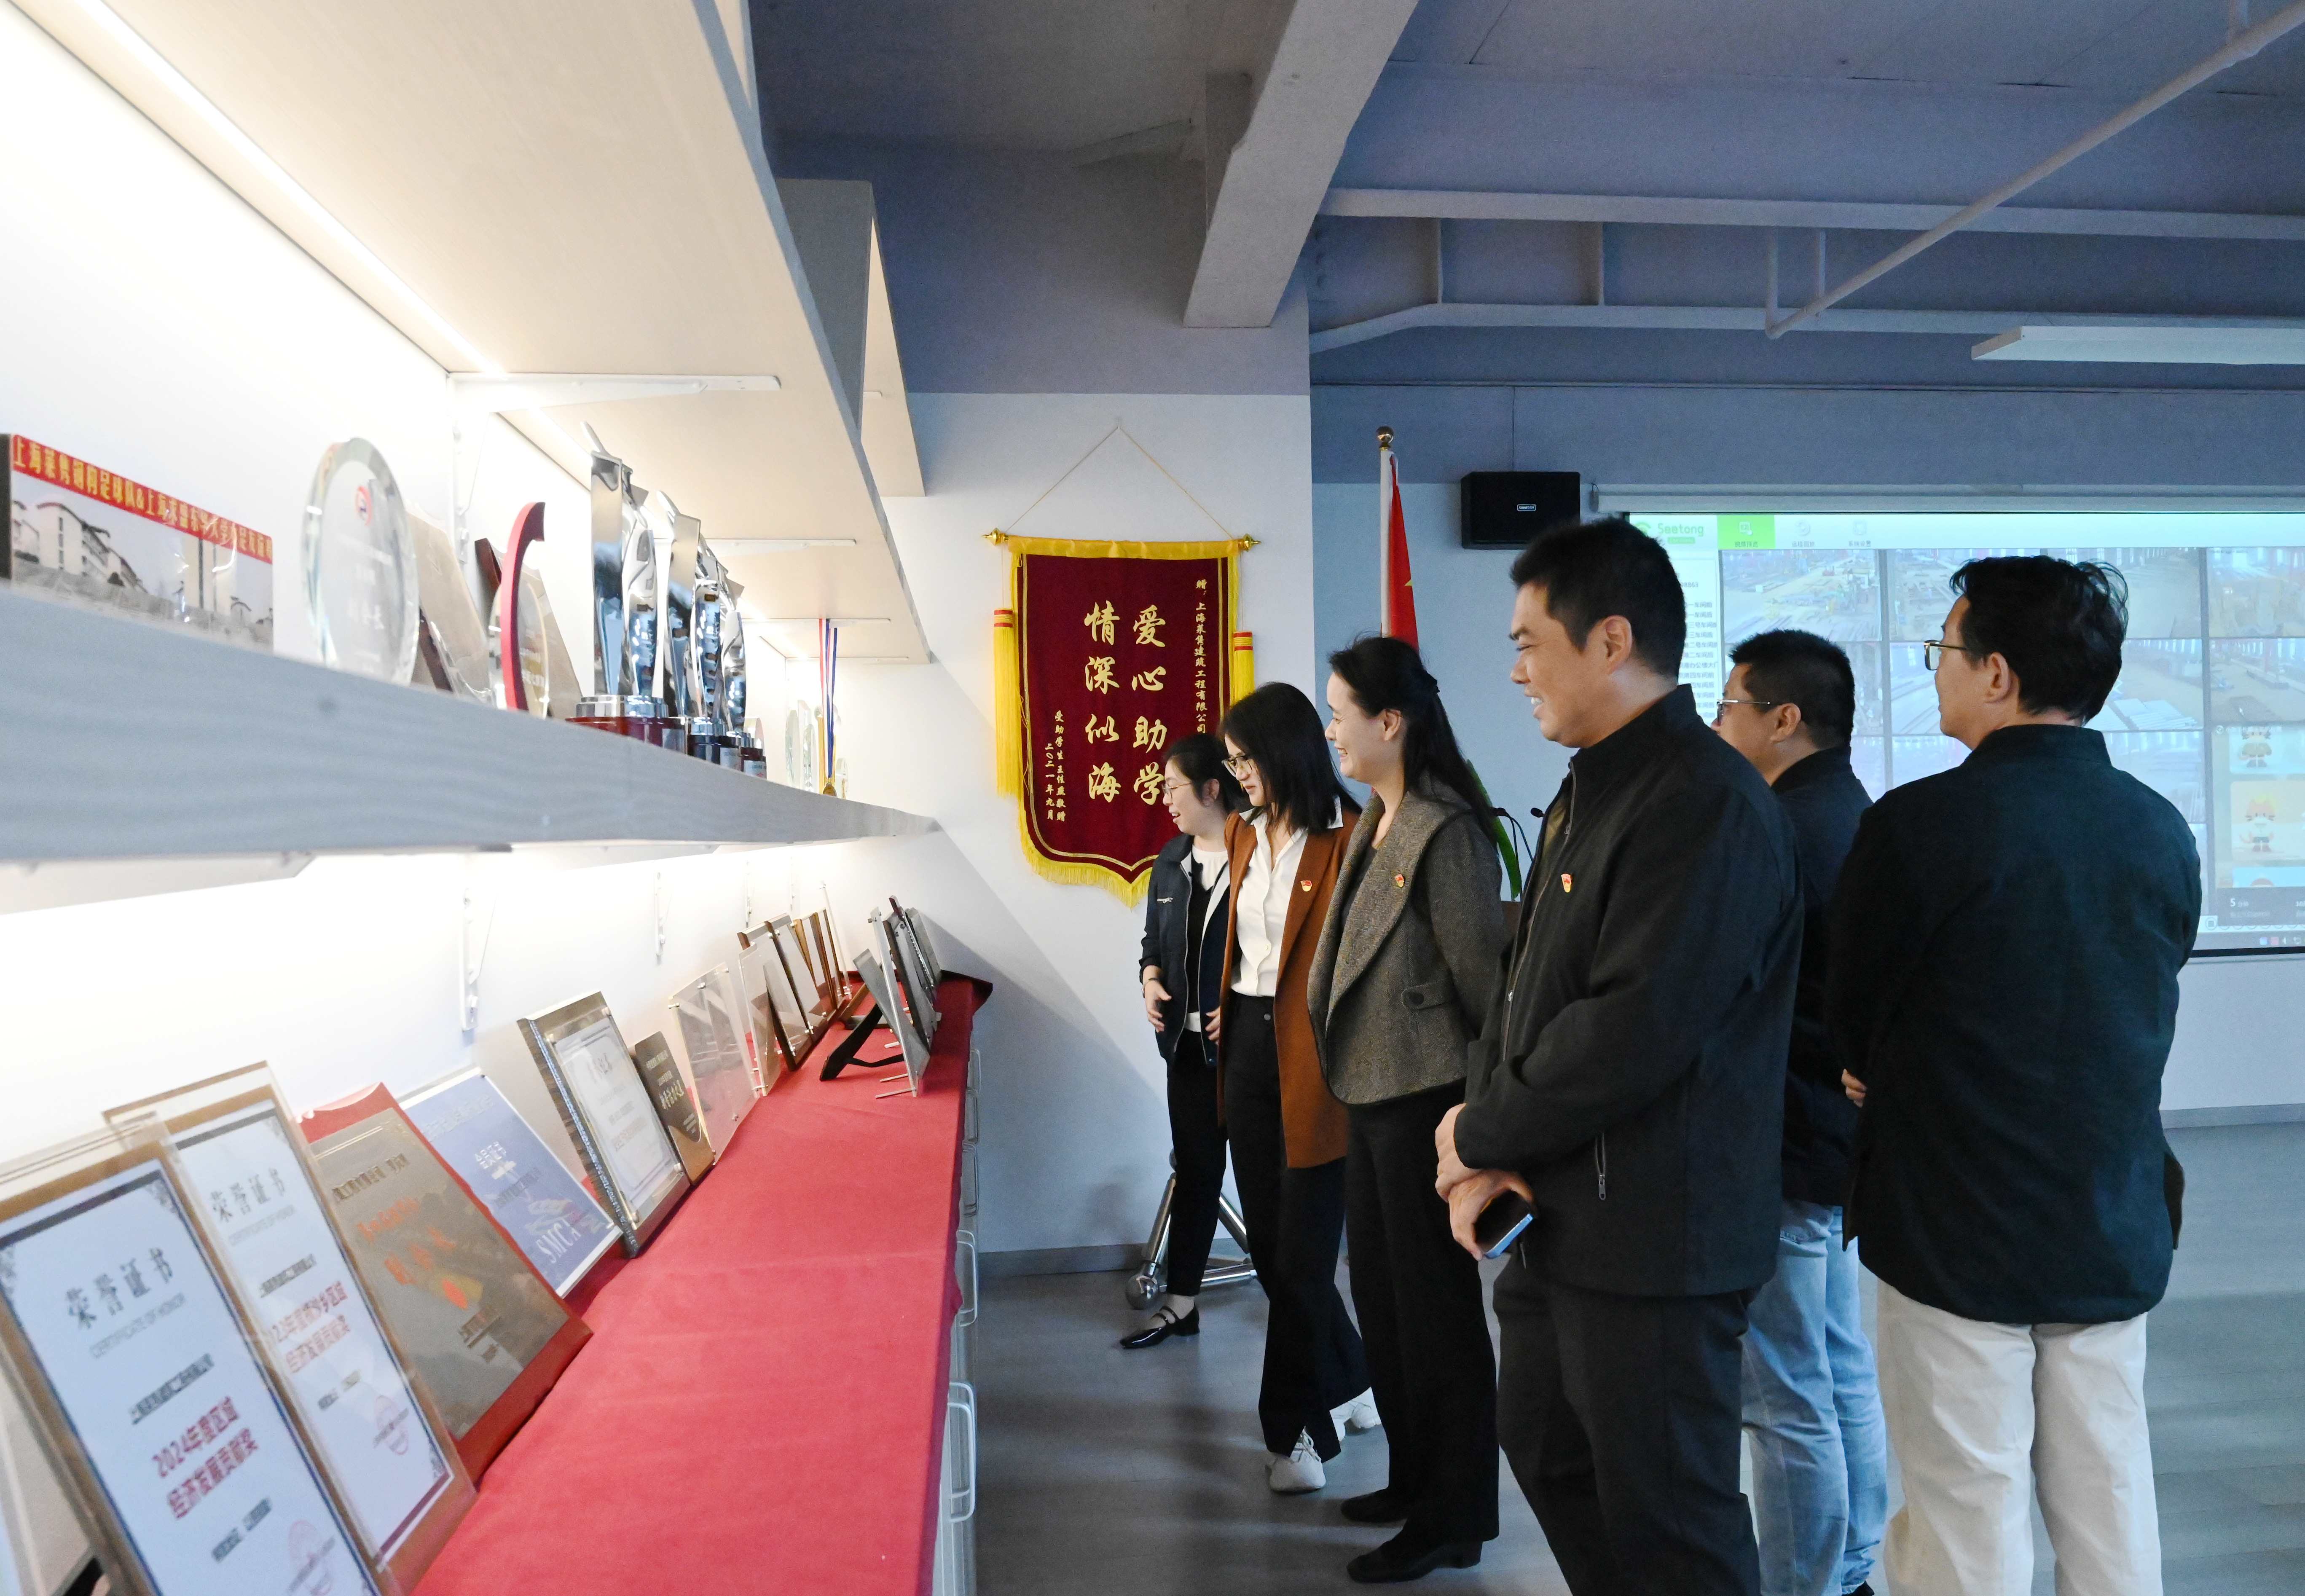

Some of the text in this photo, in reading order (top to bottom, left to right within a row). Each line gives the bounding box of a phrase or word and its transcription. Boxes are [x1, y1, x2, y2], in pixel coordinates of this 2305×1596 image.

[1657, 523, 1704, 536] Seetong
[1084, 600, 1122, 803] 情深似海
[1131, 604, 1167, 805] 爱心助学
[2230, 898, 2236, 907] 5
[211, 1168, 285, 1222] 荣誉证书
[67, 1247, 173, 1329] 荣誉证书
